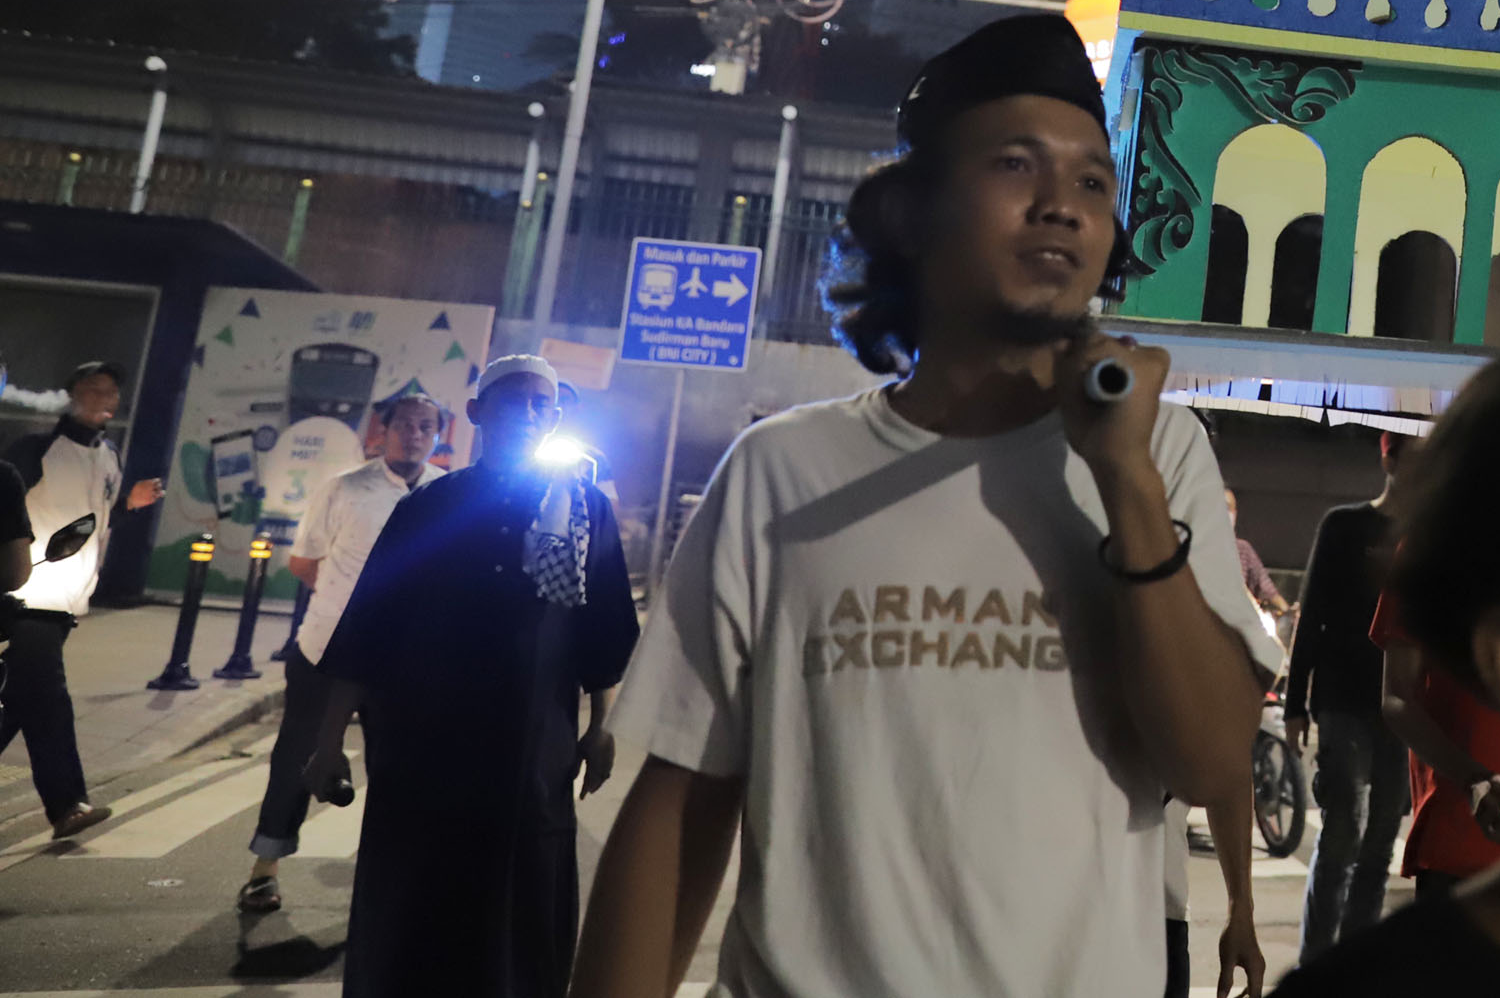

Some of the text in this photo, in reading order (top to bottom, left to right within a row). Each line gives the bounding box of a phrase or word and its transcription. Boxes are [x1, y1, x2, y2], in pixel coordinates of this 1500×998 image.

[644, 247, 747, 268] Masuk dan Parkir
[630, 313, 673, 328] Stasiun
[696, 318, 744, 333] Bandara
[642, 330, 729, 349] Sudirman Baru
[828, 584, 1060, 628] ARMAN
